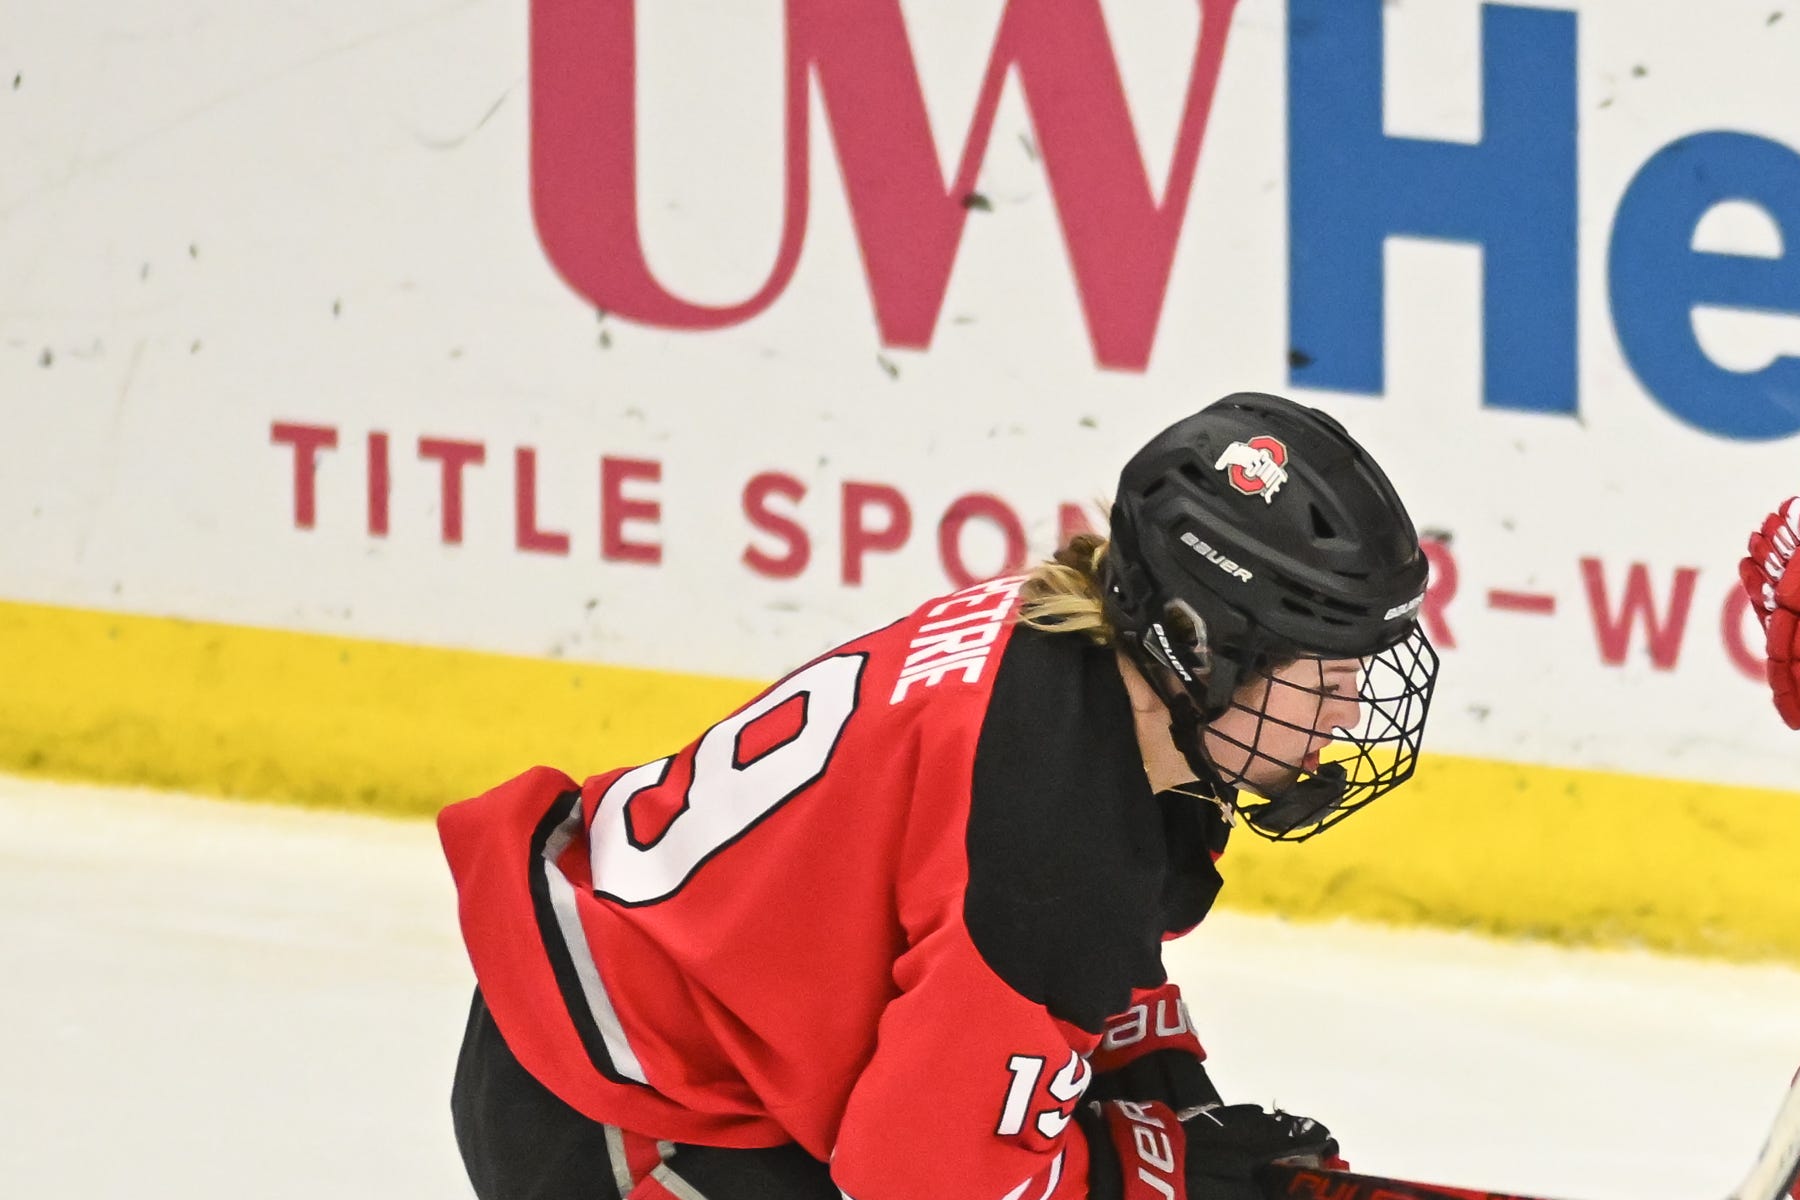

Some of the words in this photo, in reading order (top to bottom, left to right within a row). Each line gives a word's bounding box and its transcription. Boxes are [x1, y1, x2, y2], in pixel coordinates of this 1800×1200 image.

[270, 421, 662, 567] TITLE
[1179, 532, 1253, 583] BAUER
[1152, 623, 1193, 682] BAUER
[996, 1050, 1092, 1139] 19
